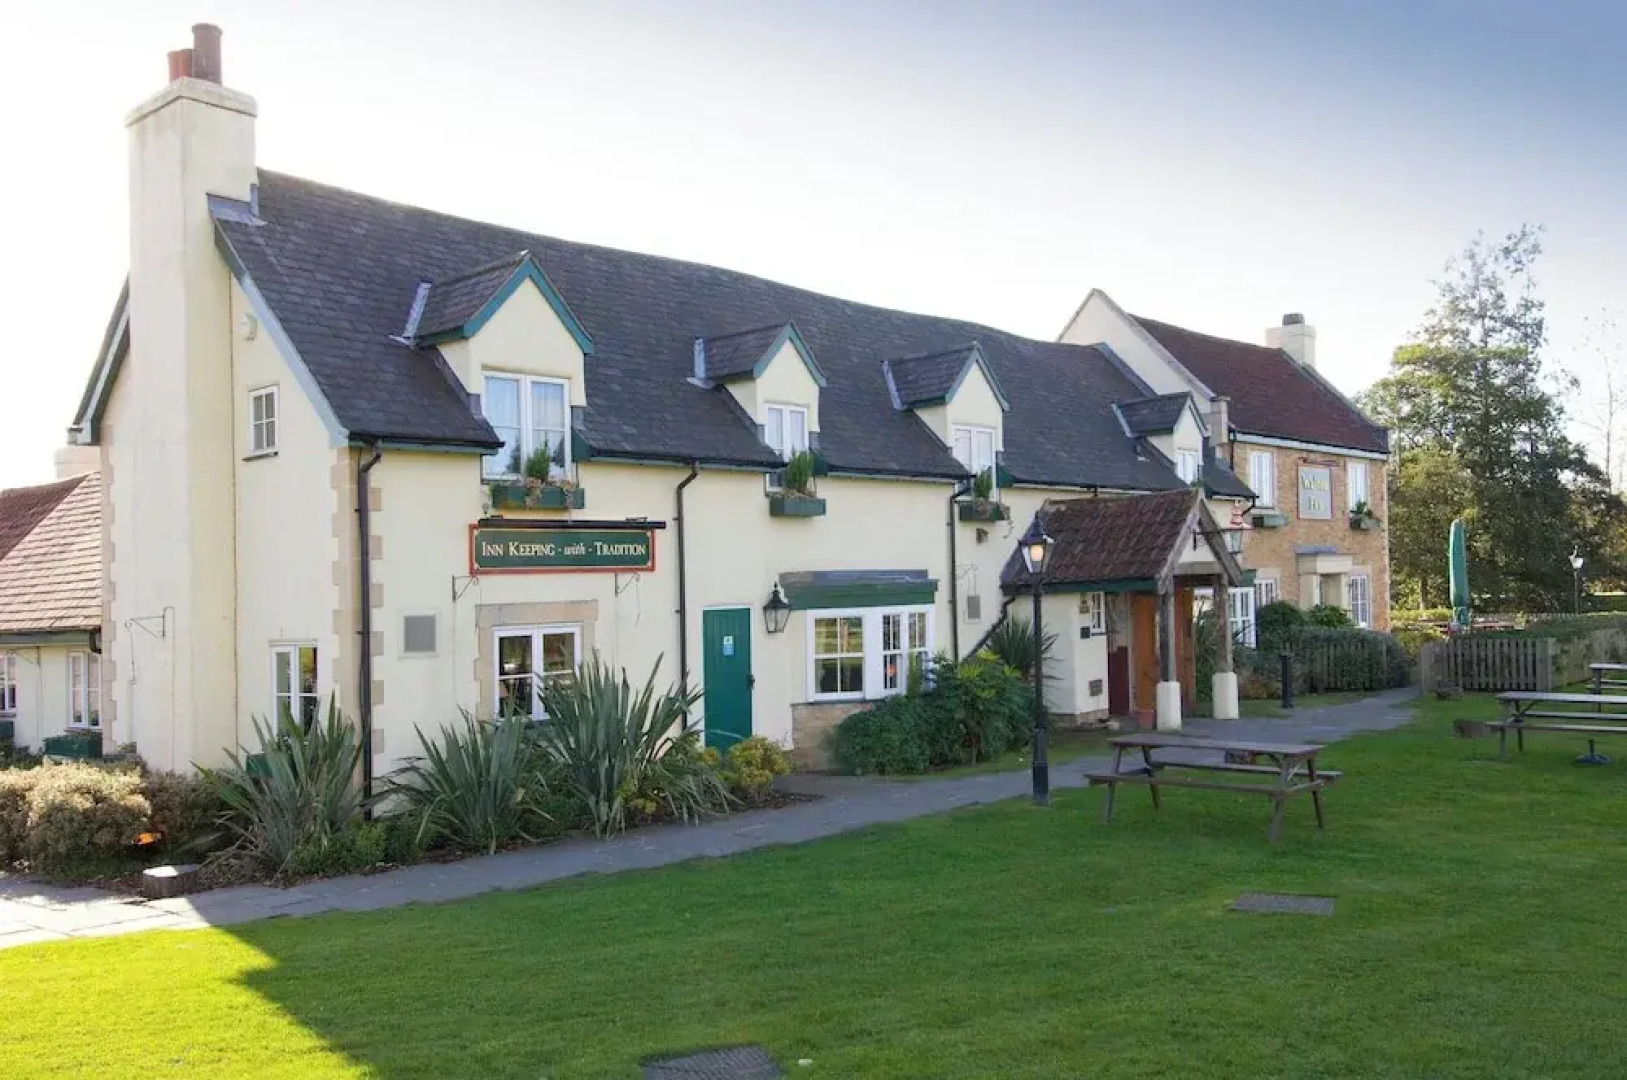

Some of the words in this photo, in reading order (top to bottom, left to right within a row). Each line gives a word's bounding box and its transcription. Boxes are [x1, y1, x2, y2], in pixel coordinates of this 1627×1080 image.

[482, 541, 504, 556] INN
[508, 541, 556, 556] KEEPING
[564, 542, 587, 556] with
[594, 541, 646, 556] TRADITION
